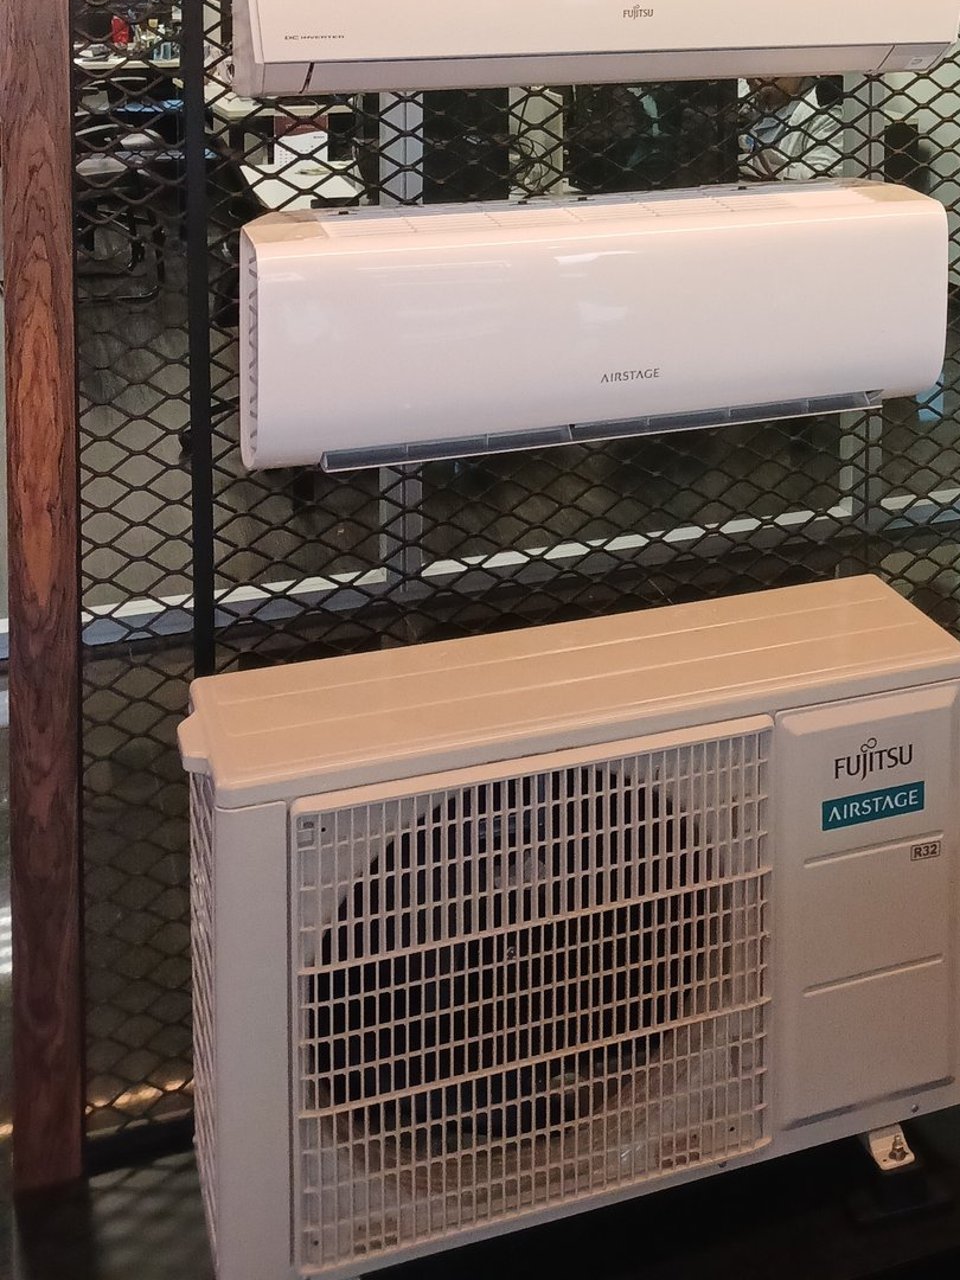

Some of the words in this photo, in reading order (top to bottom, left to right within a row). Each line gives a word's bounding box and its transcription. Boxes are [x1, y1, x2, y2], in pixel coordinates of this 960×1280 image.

[623, 4, 653, 19] FUJITSU
[600, 368, 660, 383] AIRSTAGE
[834, 737, 914, 781] FUJITSU
[828, 789, 919, 823] AIRSTAGE
[913, 845, 938, 858] R32
